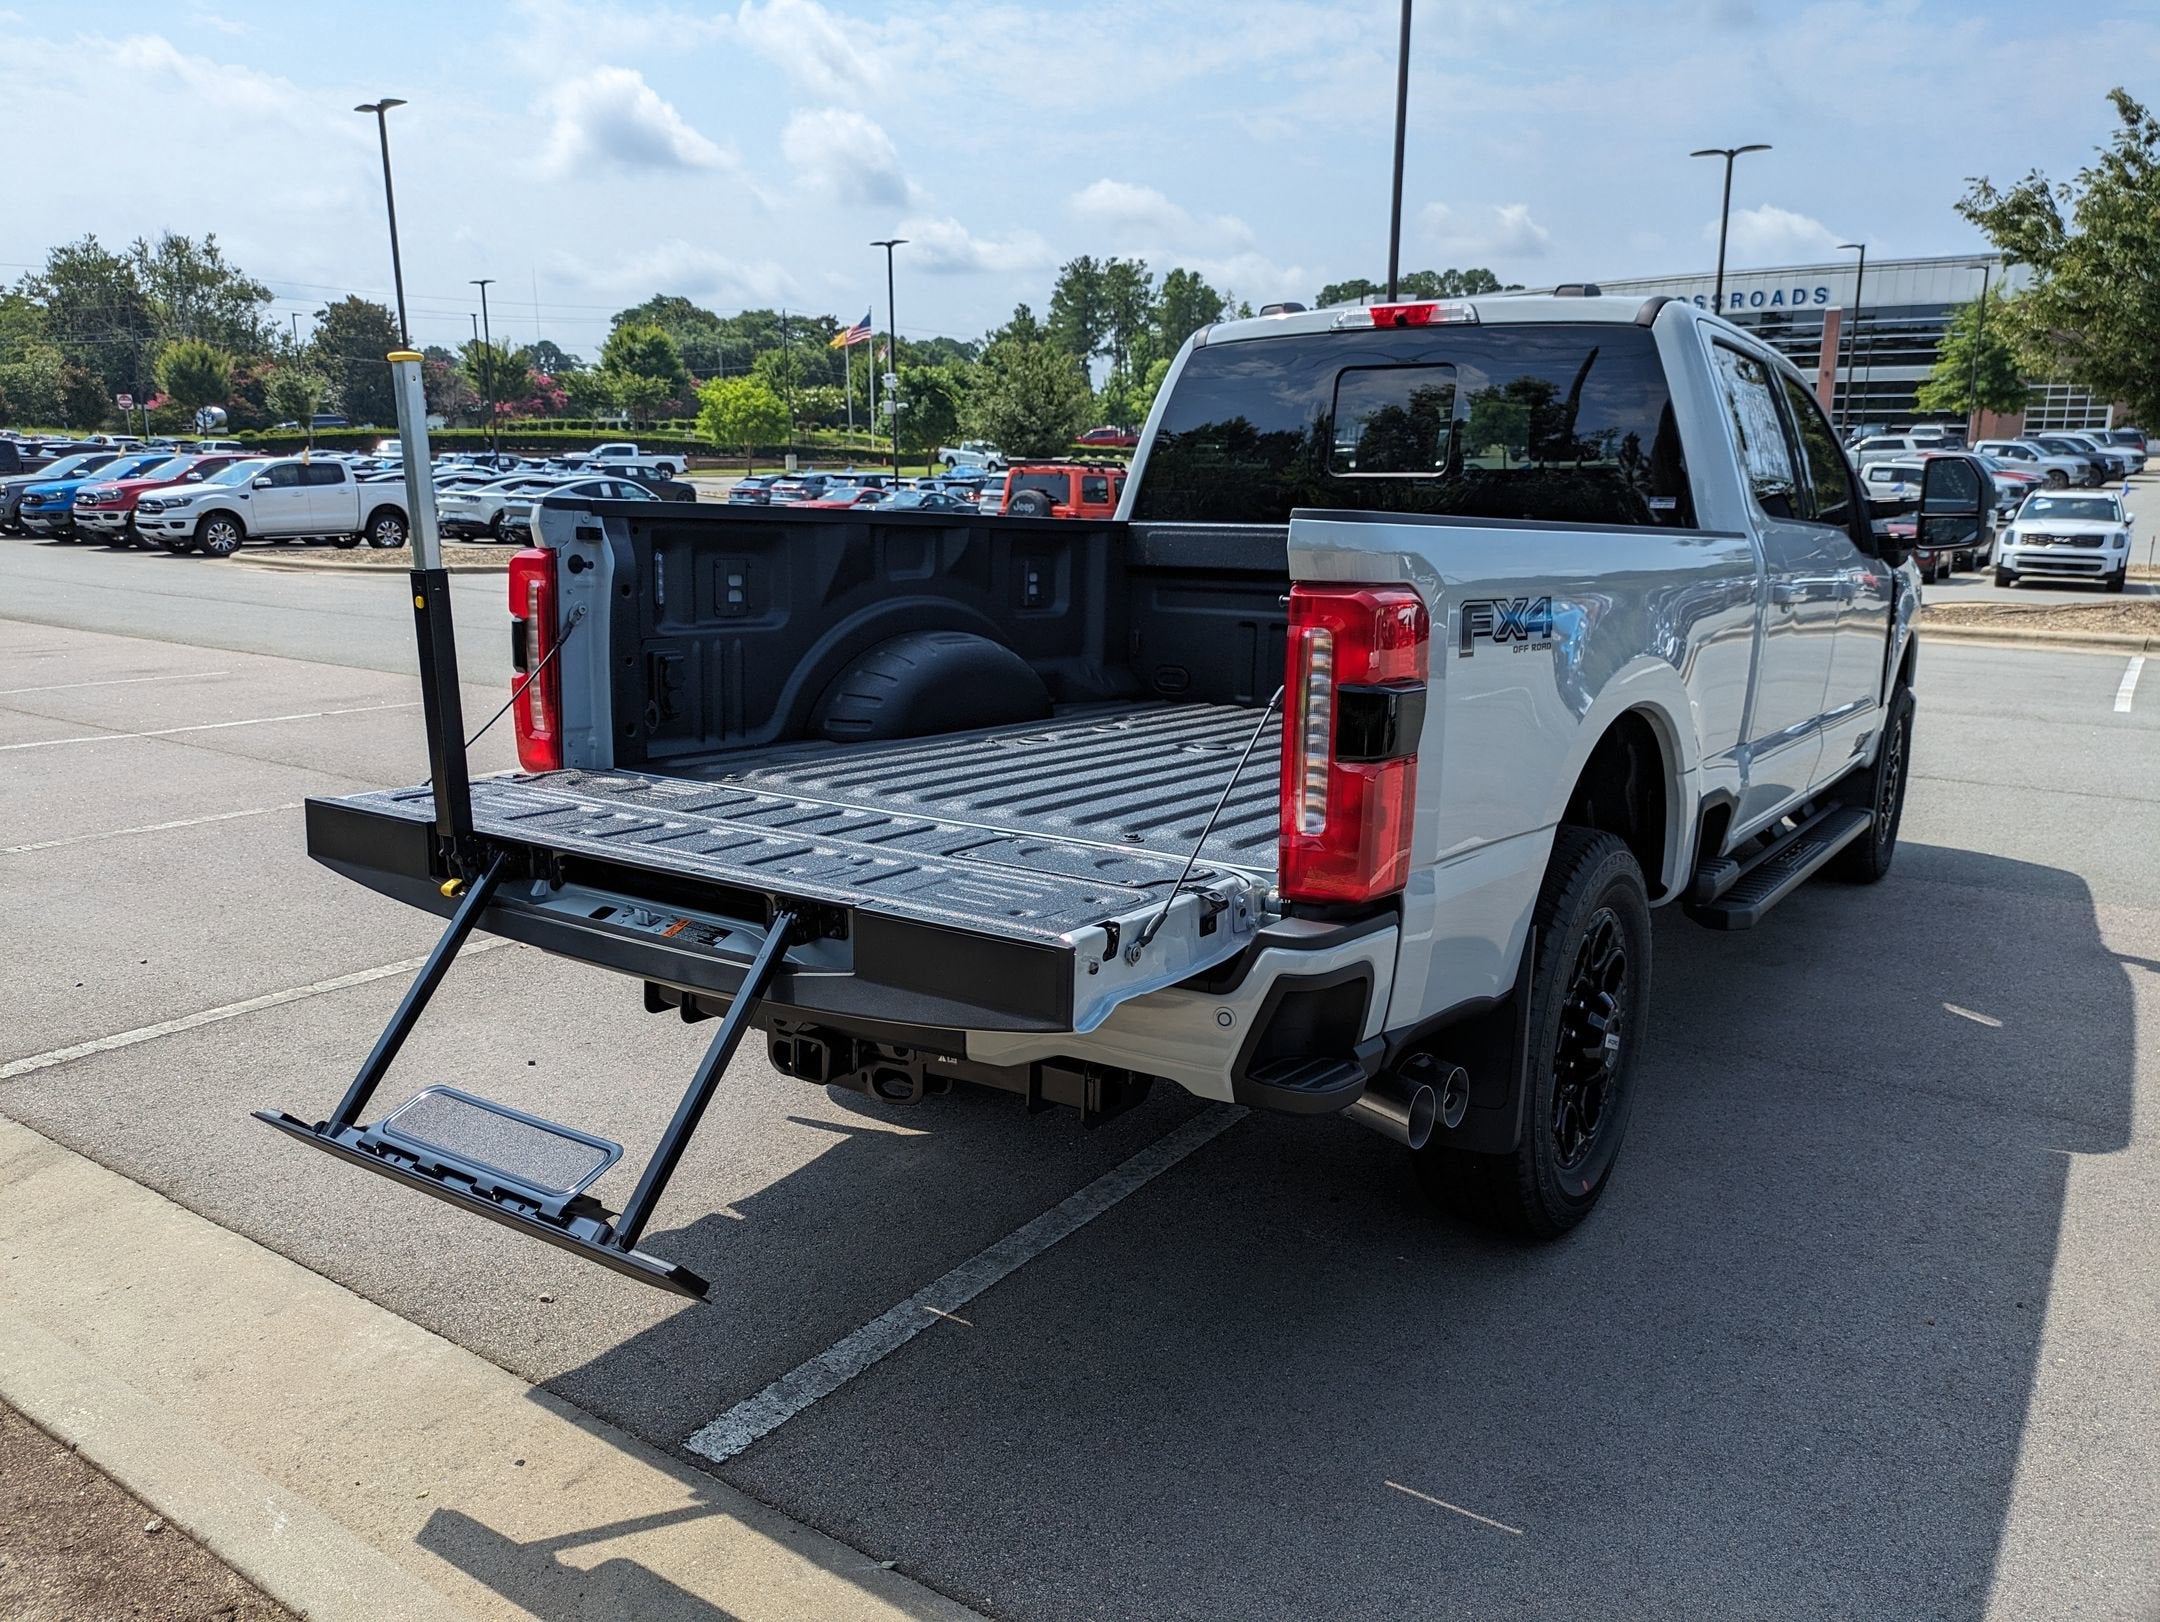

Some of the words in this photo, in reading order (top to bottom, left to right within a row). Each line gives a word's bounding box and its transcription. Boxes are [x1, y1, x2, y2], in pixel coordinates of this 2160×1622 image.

[1013, 500, 1035, 513] Jeep
[1459, 596, 1553, 659] FX4
[1513, 645, 1529, 654] OFF
[1531, 642, 1552, 652] ROAD
